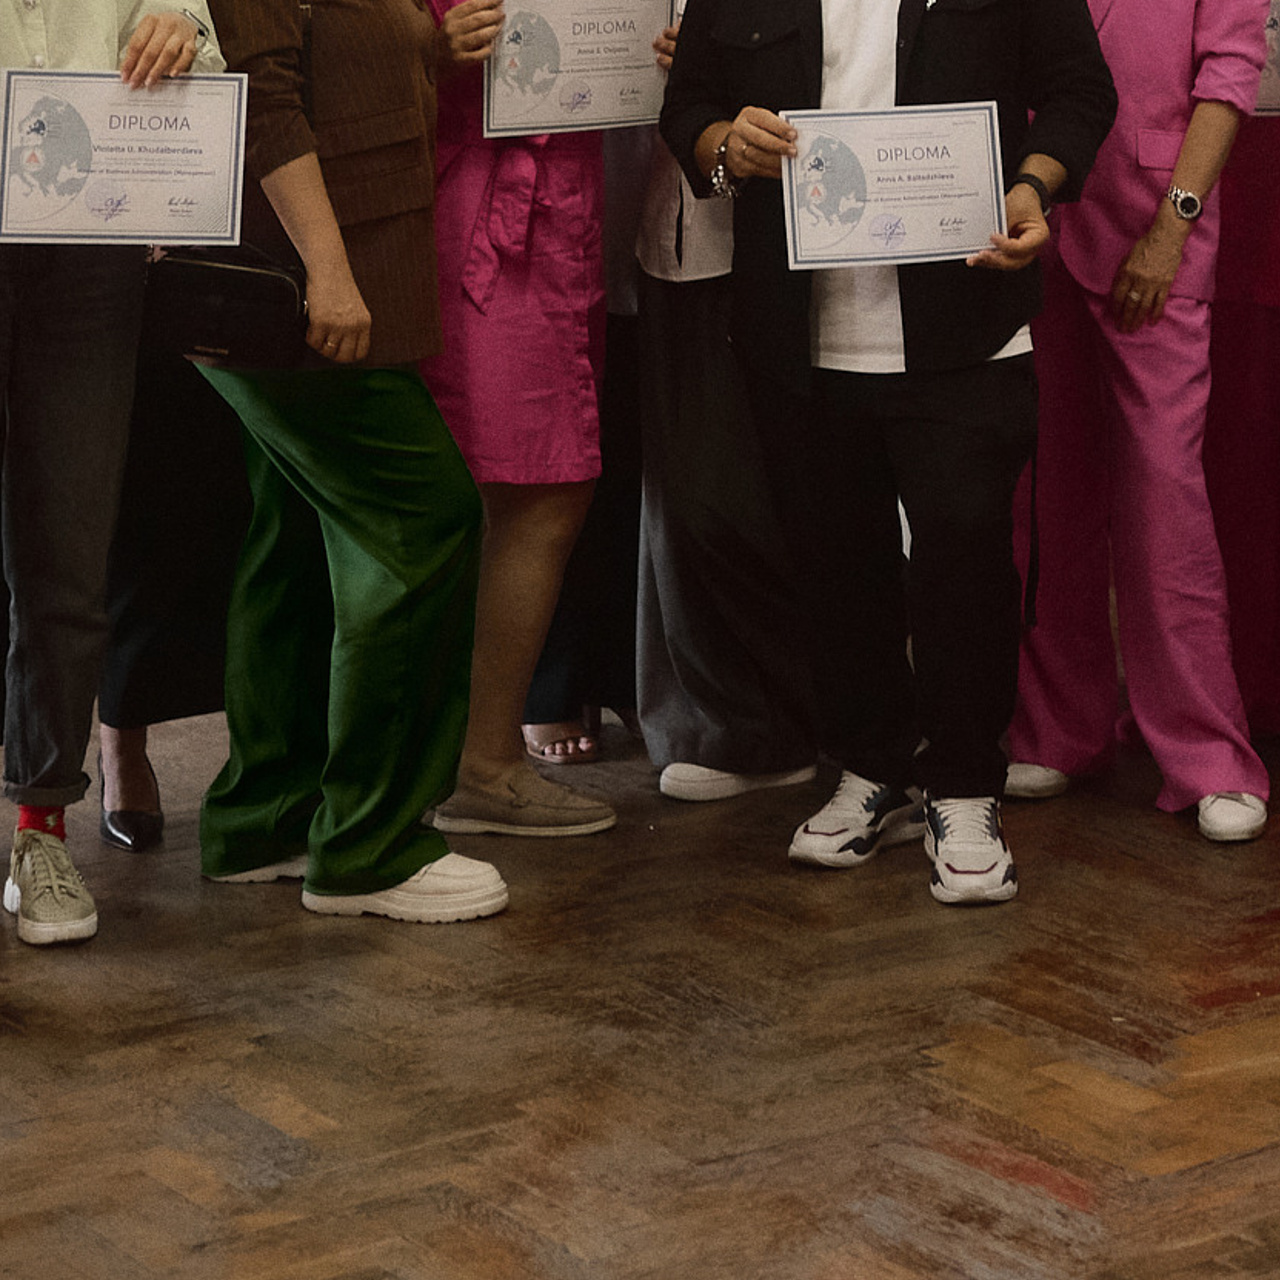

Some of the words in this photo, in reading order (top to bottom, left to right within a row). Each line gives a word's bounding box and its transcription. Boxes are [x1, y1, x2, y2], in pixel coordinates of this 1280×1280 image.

[572, 19, 637, 36] DIPLOMA
[108, 114, 191, 131] DIPLOMA
[876, 145, 951, 162] DIPLOMA
